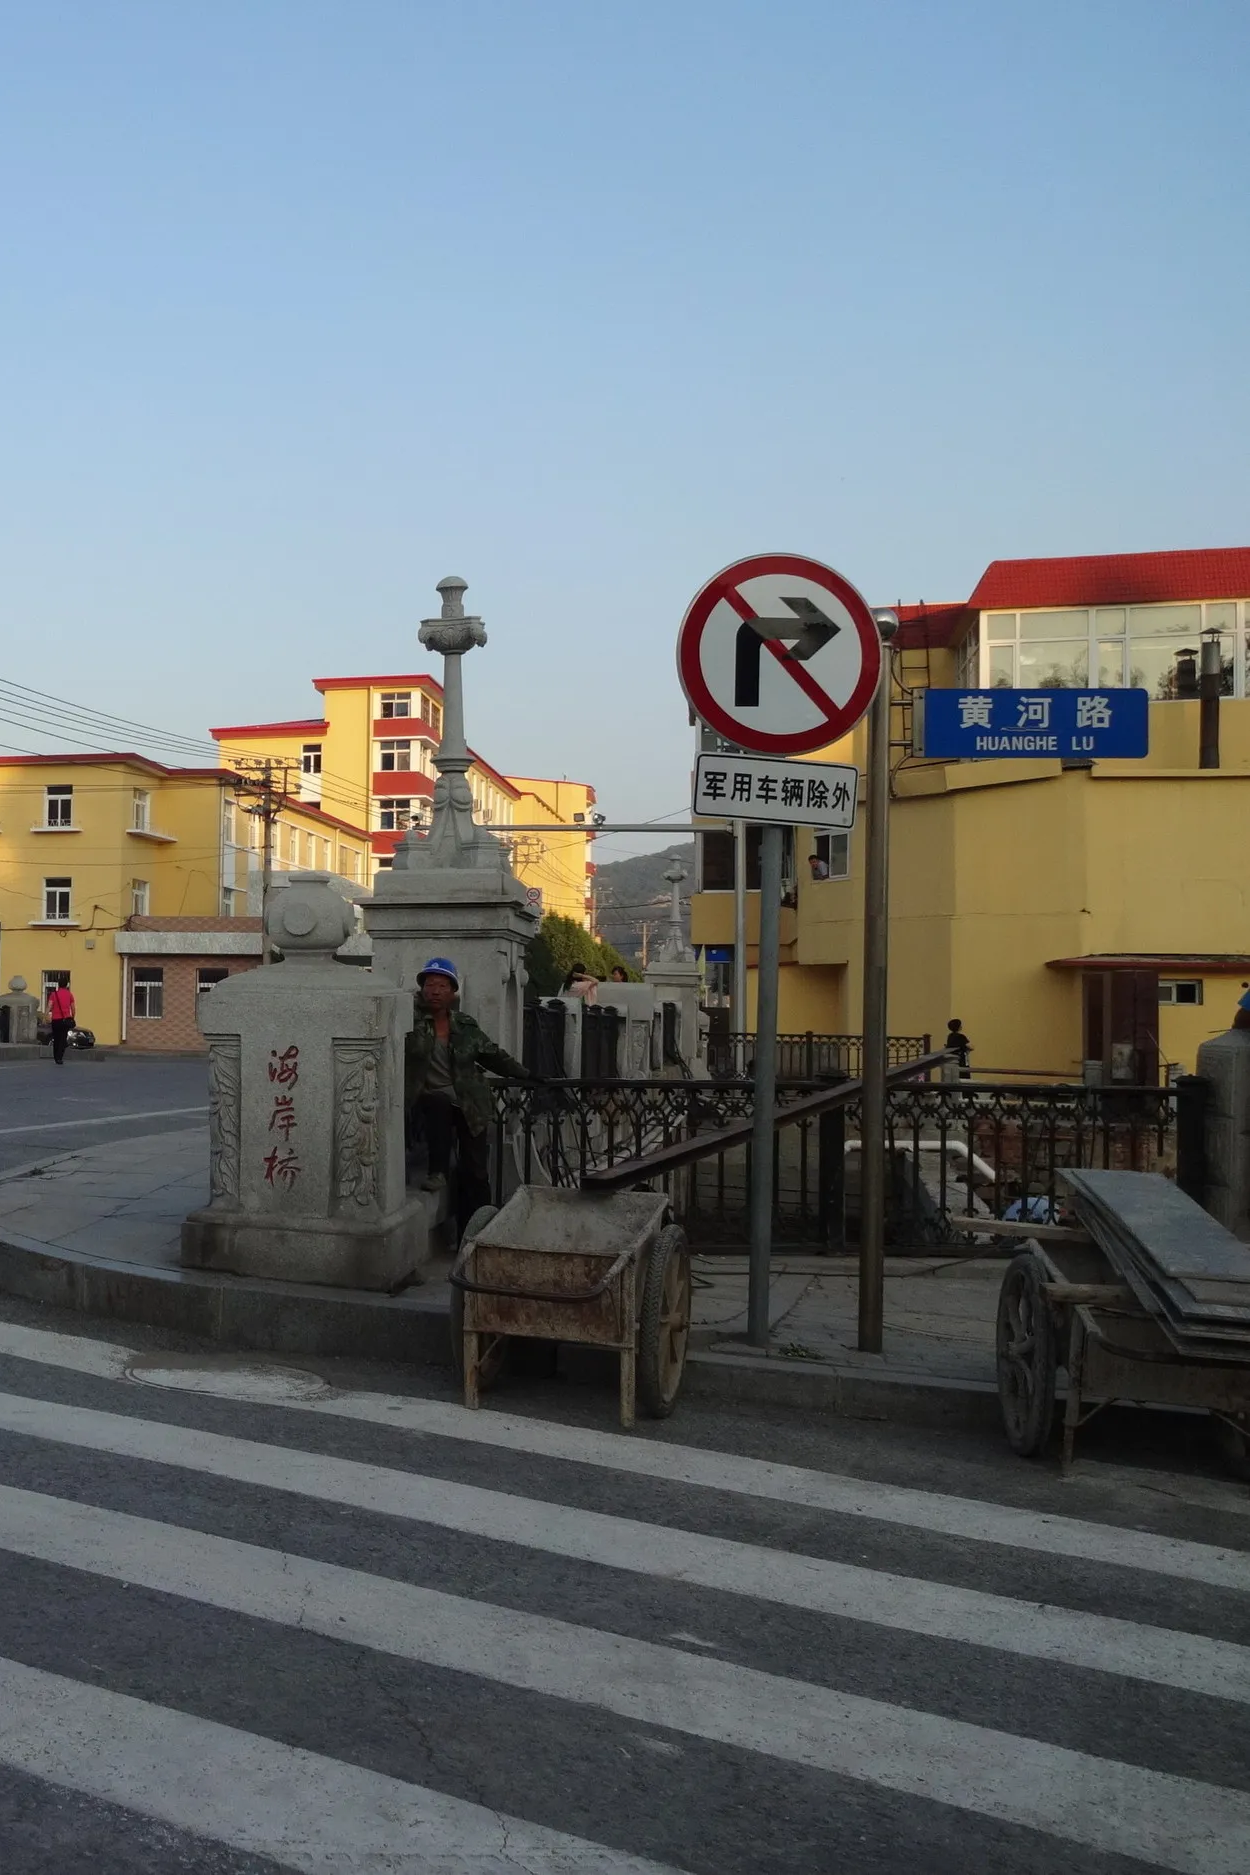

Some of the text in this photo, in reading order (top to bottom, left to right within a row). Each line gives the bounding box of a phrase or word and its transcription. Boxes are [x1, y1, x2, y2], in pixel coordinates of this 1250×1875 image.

[958, 696, 1113, 729] 黄河路
[976, 736, 1095, 750] HUANGHE LU
[702, 771, 851, 812] 军用车辆除外
[263, 1045, 301, 1193] 海岸桥
